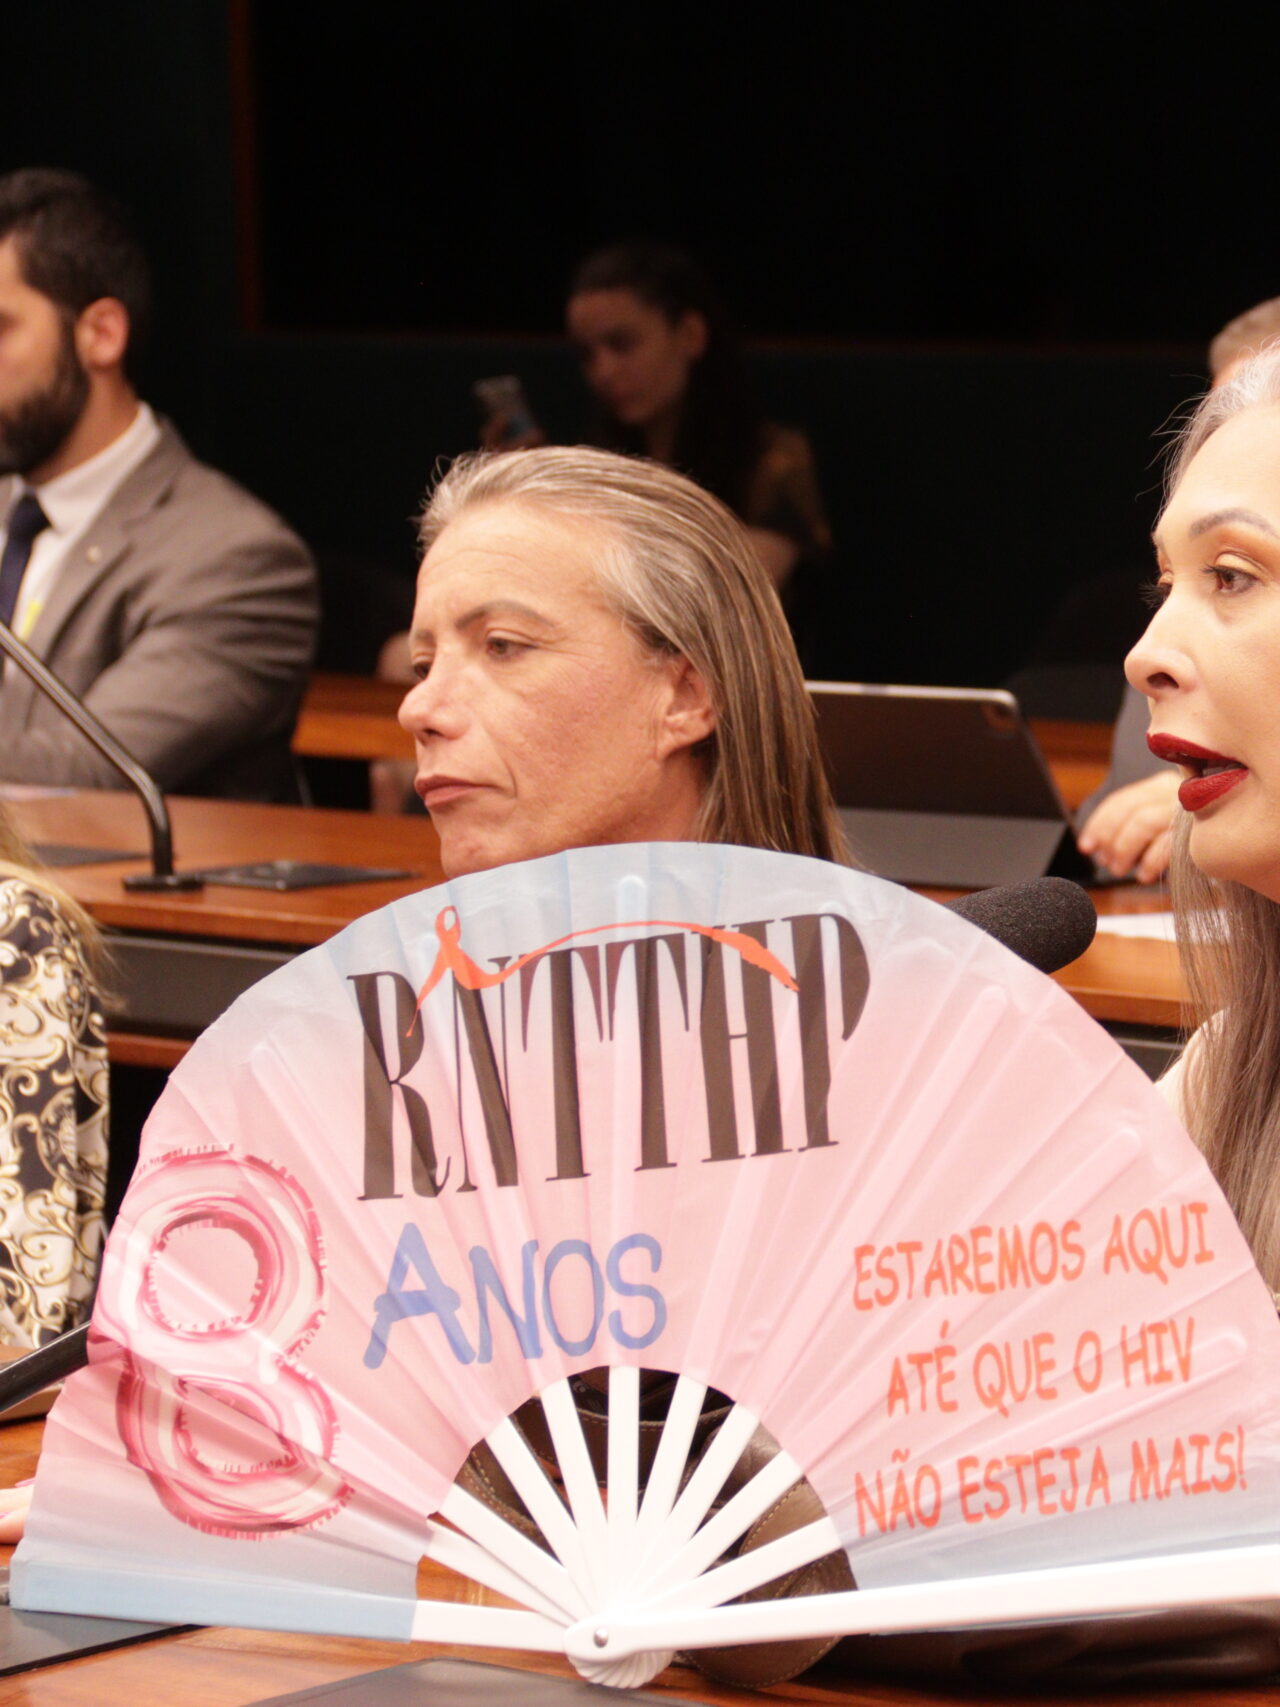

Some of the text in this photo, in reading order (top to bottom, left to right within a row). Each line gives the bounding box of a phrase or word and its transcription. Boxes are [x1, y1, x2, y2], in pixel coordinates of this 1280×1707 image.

[346, 913, 871, 1201] RNTTHP
[852, 1202, 1215, 1311] ESTAREMOS AQUI
[88, 1143, 668, 1541] 8 ANOS
[886, 1317, 1195, 1418] ATÉ QUE O HIV
[854, 1425, 1247, 1537] NÃO ESTEJA MAIS!
